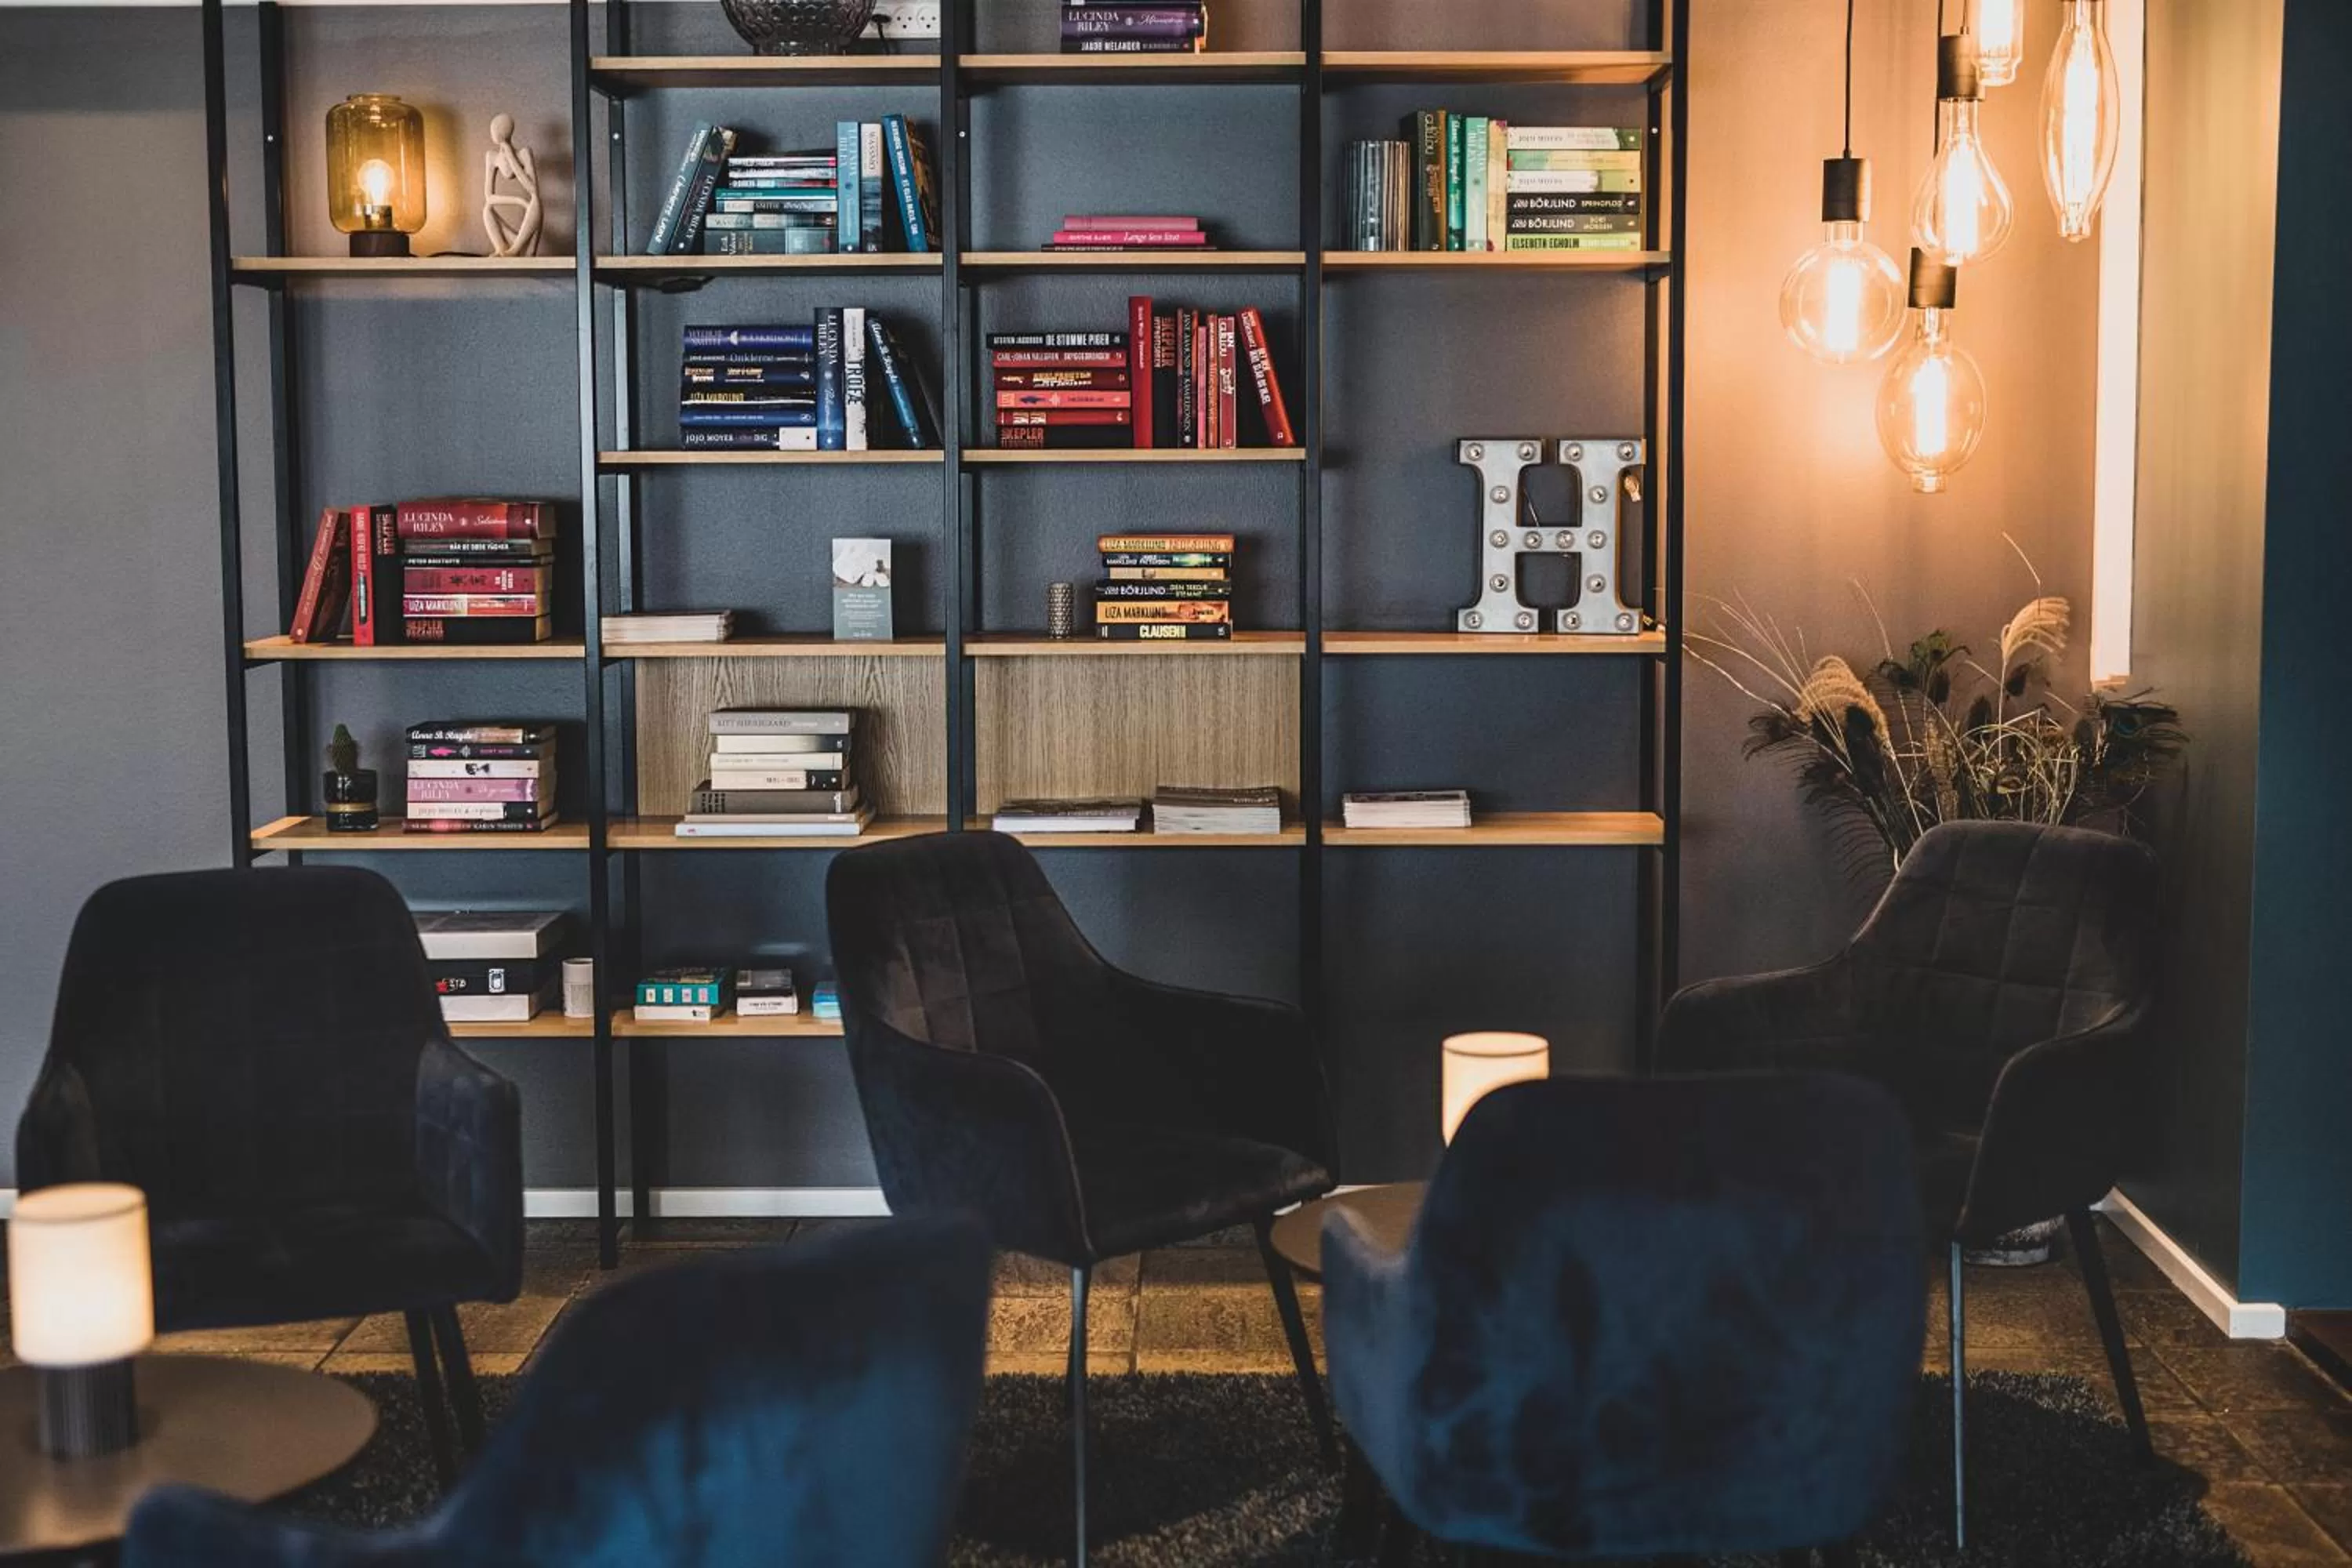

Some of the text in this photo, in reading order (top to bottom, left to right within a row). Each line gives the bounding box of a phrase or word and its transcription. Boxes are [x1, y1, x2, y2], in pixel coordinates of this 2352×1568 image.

[1069, 11, 1119, 21] LUCINDA
[1077, 22, 1110, 31] RILEY
[1512, 238, 1580, 249] ELSEBETH EGHOLM
[847, 358, 862, 405] TROFÆ
[405, 512, 453, 522] LUCINDA
[413, 523, 445, 532] RILEY
[1457, 439, 1646, 634] H
[1105, 607, 1122, 619] LIZA
